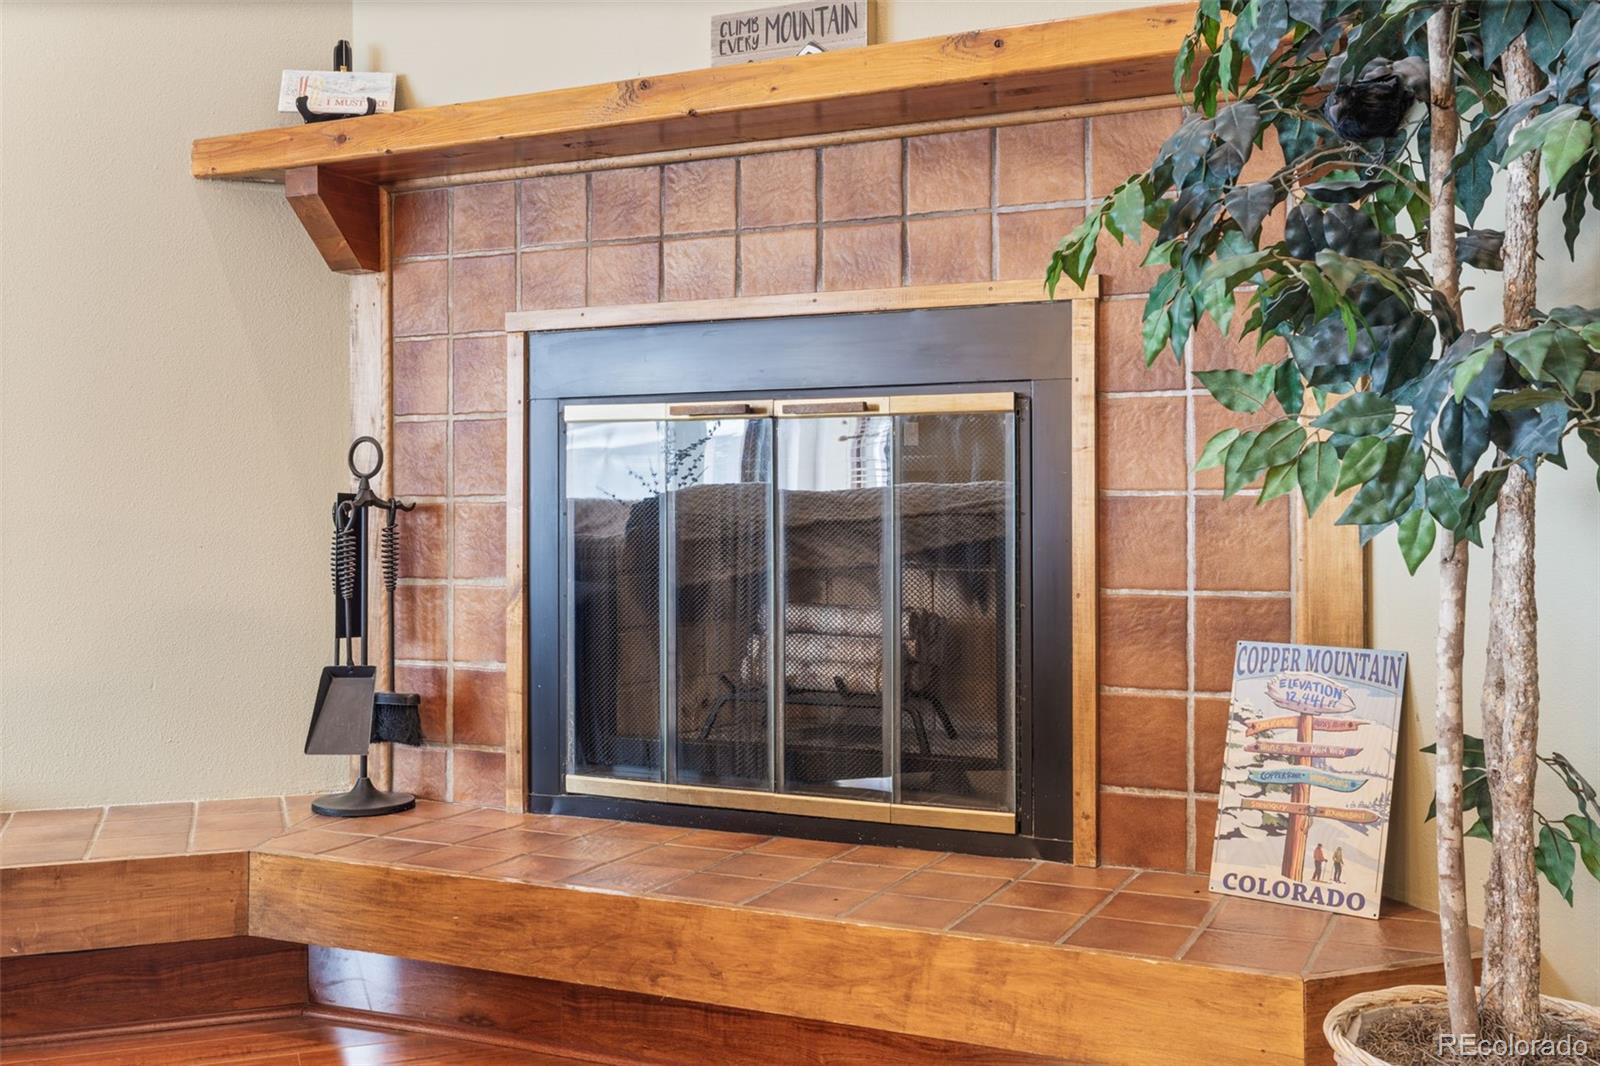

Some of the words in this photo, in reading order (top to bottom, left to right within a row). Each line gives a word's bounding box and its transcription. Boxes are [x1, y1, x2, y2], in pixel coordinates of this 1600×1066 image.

[720, 16, 759, 38] CLIMB
[765, 2, 858, 46] MOUNTAIN
[719, 34, 759, 56] EVERY
[335, 99, 364, 107] MUST
[1236, 645, 1300, 676] COPPER
[1307, 649, 1401, 689] MOUNTAIN
[1279, 678, 1343, 700] ELEVATION
[1222, 872, 1366, 912] COLORADO
